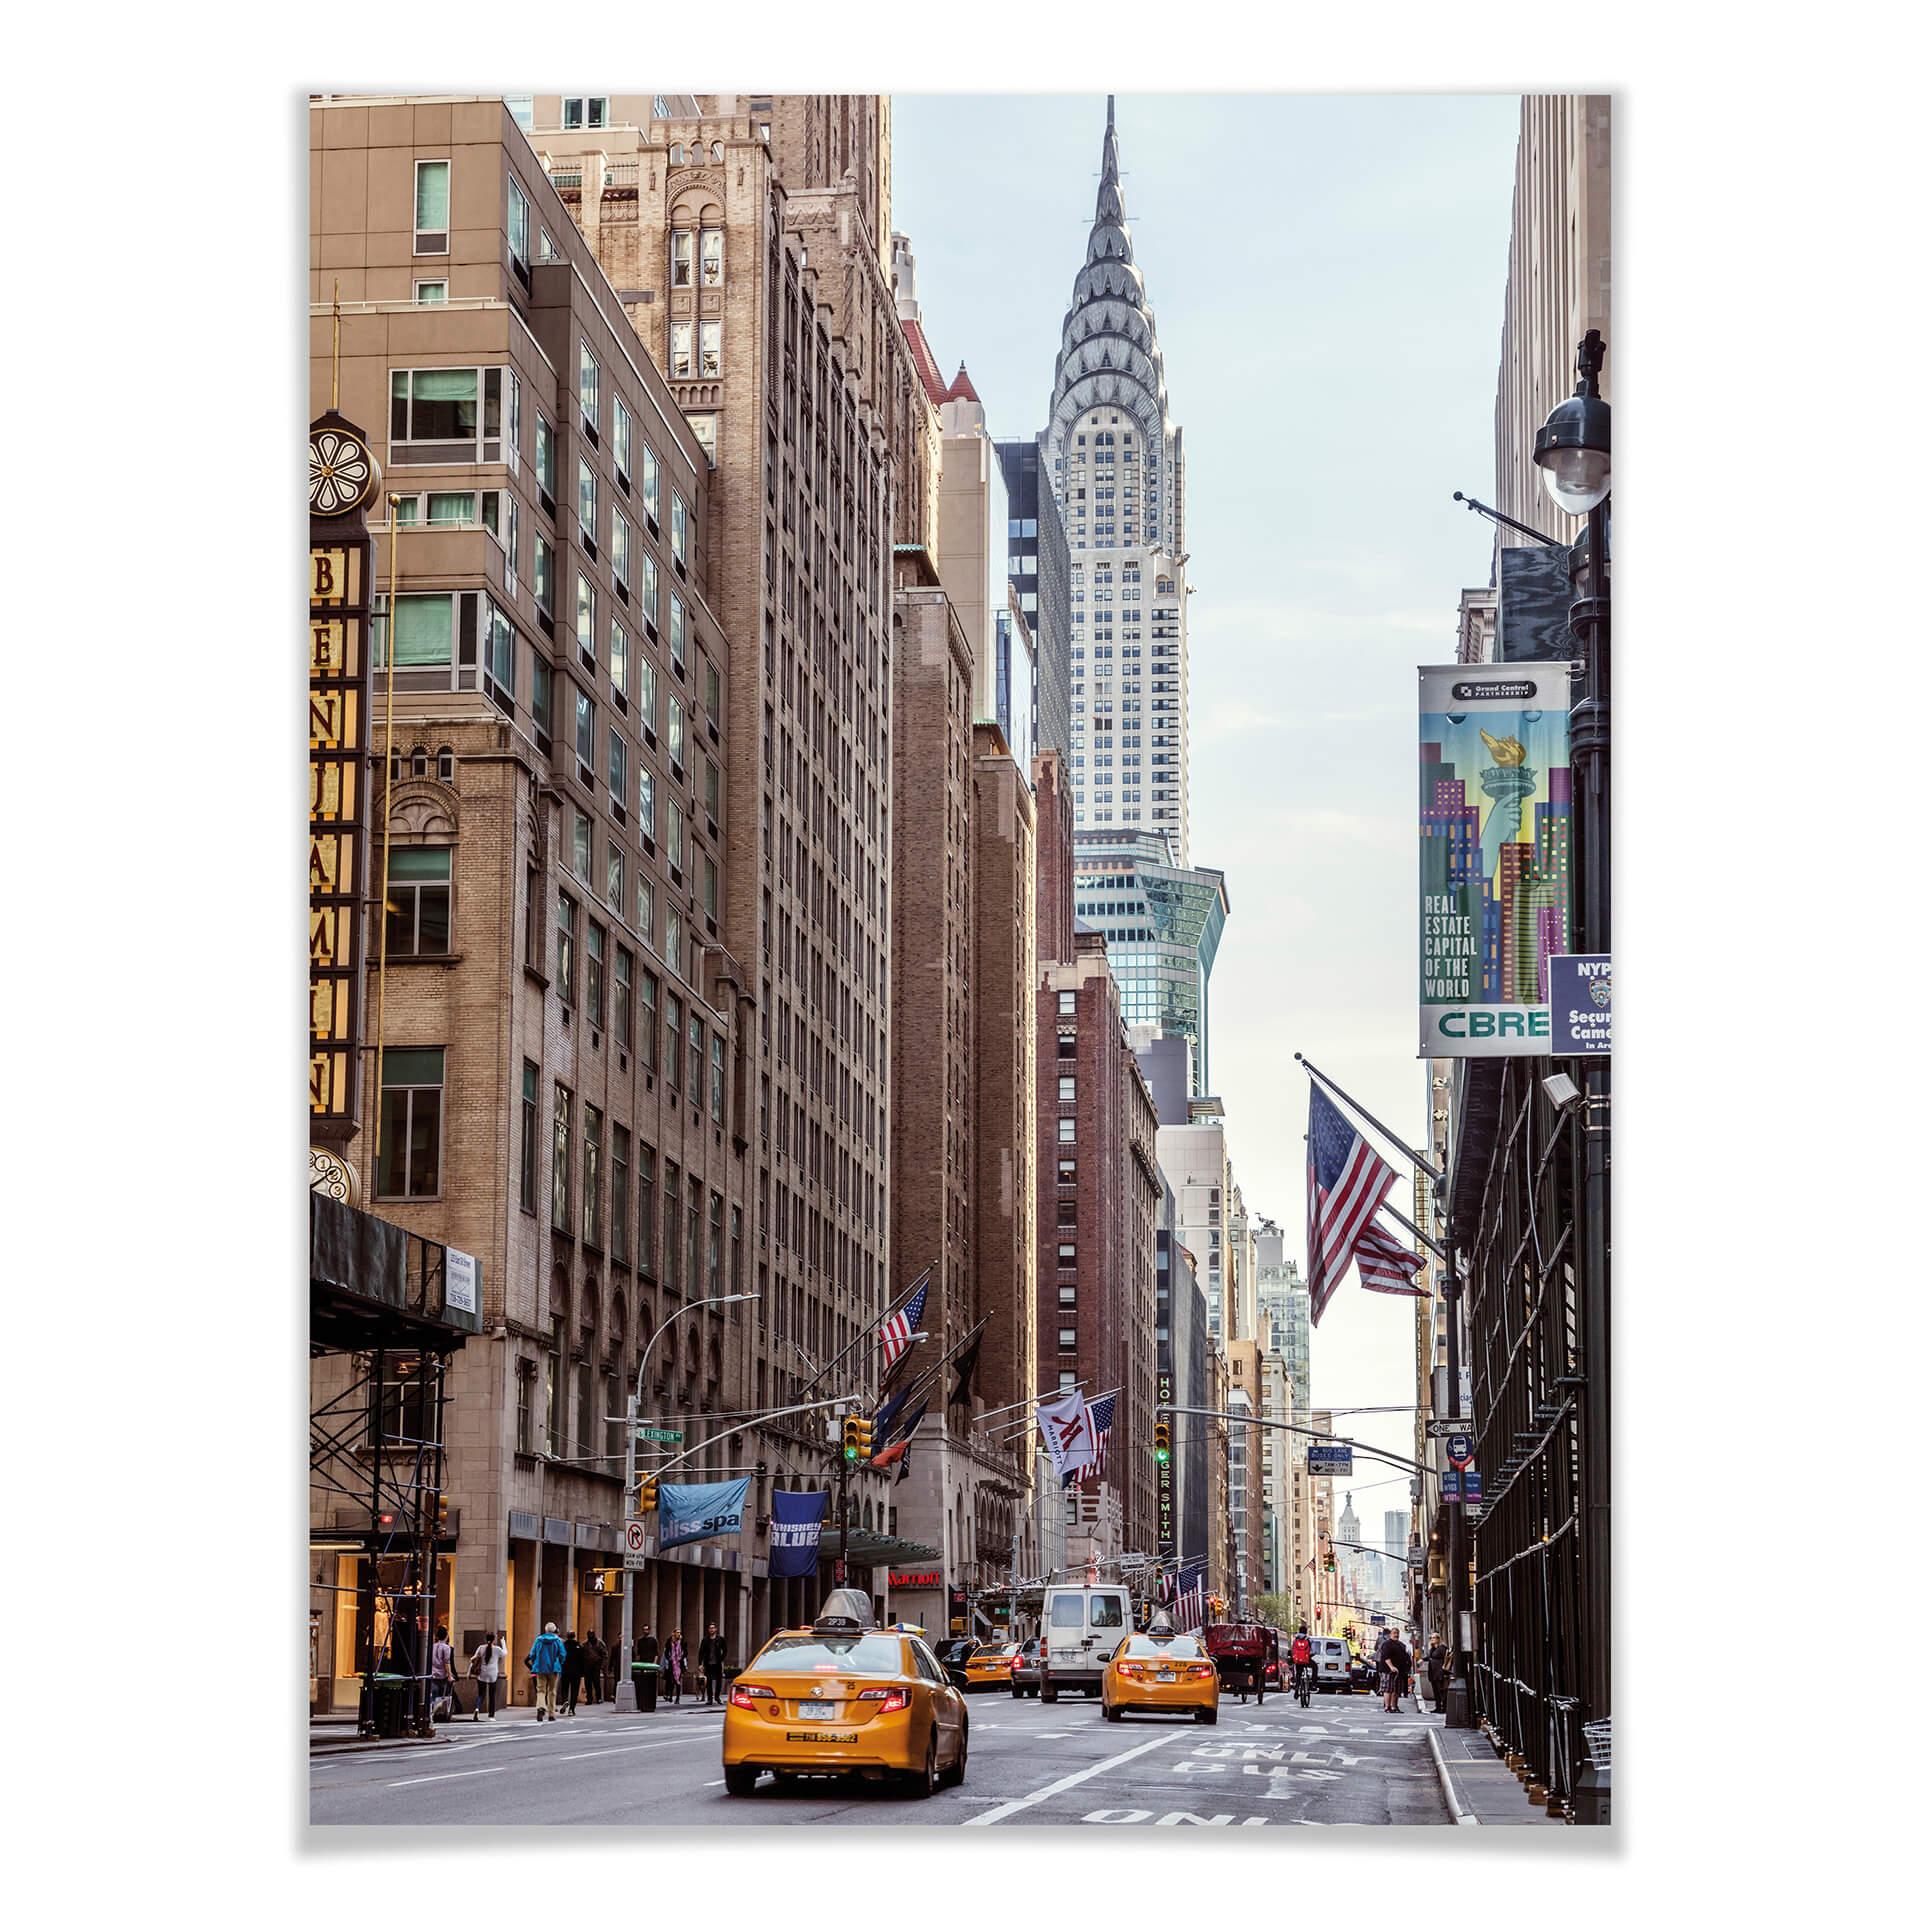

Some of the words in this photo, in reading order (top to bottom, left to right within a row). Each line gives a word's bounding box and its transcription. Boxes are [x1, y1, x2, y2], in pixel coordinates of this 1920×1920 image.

[1425, 895, 1457, 914] REAL
[1425, 916, 1471, 935] ESTATE
[1425, 936, 1478, 956] CAPITAL
[1425, 958, 1440, 977] OF
[1444, 957, 1469, 977] THE
[1425, 978, 1470, 998] WORLD
[1438, 1011, 1550, 1039] CBRE
[1159, 1377, 1171, 1425] HOTE
[1432, 1424, 1450, 1433] ONE
[1459, 1424, 1472, 1432] WA
[1047, 1424, 1063, 1465] MARRIOTT
[701, 1513, 740, 1532] spa
[1161, 1493, 1172, 1539] SMITH
[770, 1531, 819, 1547] BLUE
[1172, 1761, 1348, 1781] BUS
